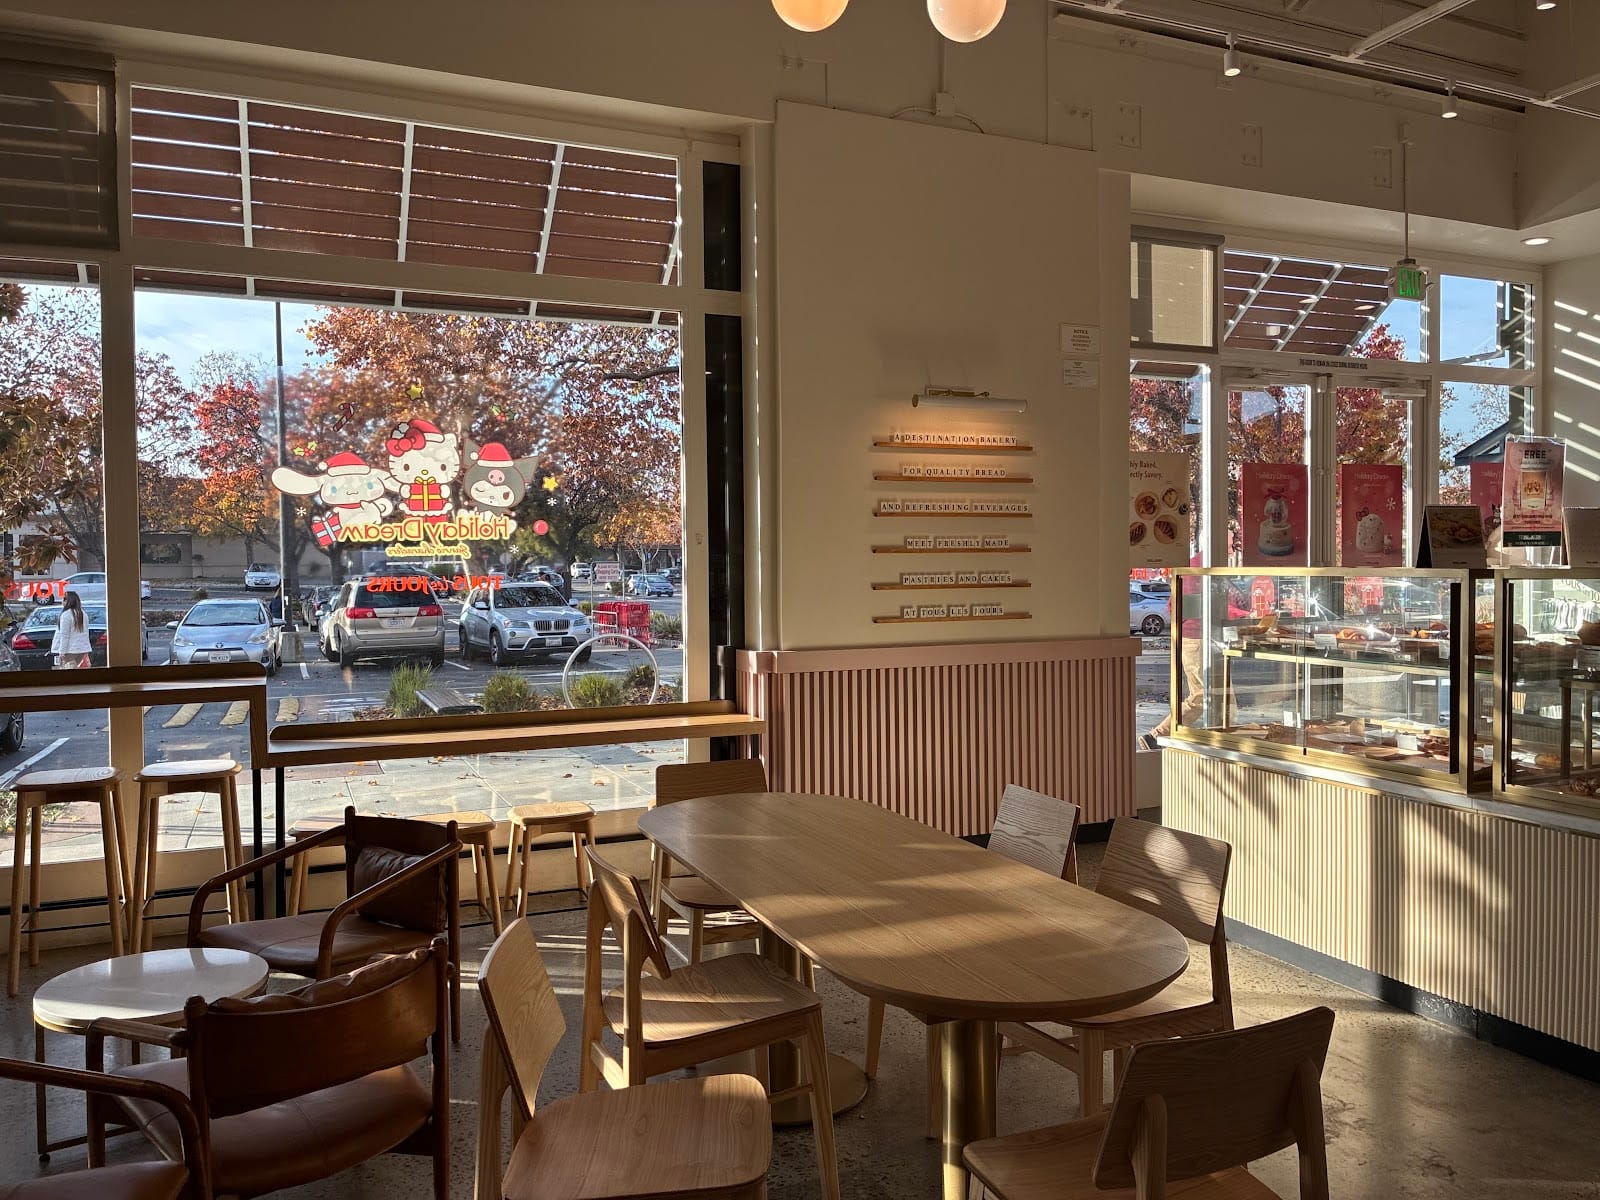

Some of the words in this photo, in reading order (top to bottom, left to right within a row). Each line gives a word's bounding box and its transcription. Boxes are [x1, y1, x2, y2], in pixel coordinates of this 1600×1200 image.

[905, 434, 975, 443] DESTINATION
[980, 436, 1016, 444] BAKERY
[1524, 450, 1547, 460] FREE
[903, 467, 922, 475] FOR
[926, 468, 970, 476] QUALITY
[975, 469, 1006, 477] BREAD
[882, 503, 901, 511] AND
[905, 503, 969, 511] REFRESHING
[974, 504, 1028, 512] BEVERAGES
[906, 539, 933, 548] MEET
[937, 539, 981, 548] FRESHLY
[985, 538, 1009, 547] MADE
[904, 574, 954, 583] PASTRIES
[959, 574, 977, 583] AND
[981, 574, 1011, 583] CAKES
[904, 609, 917, 617] AT
[921, 608, 946, 617] TOUS
[951, 607, 969, 616] LES
[973, 606, 1003, 615] JOURS
